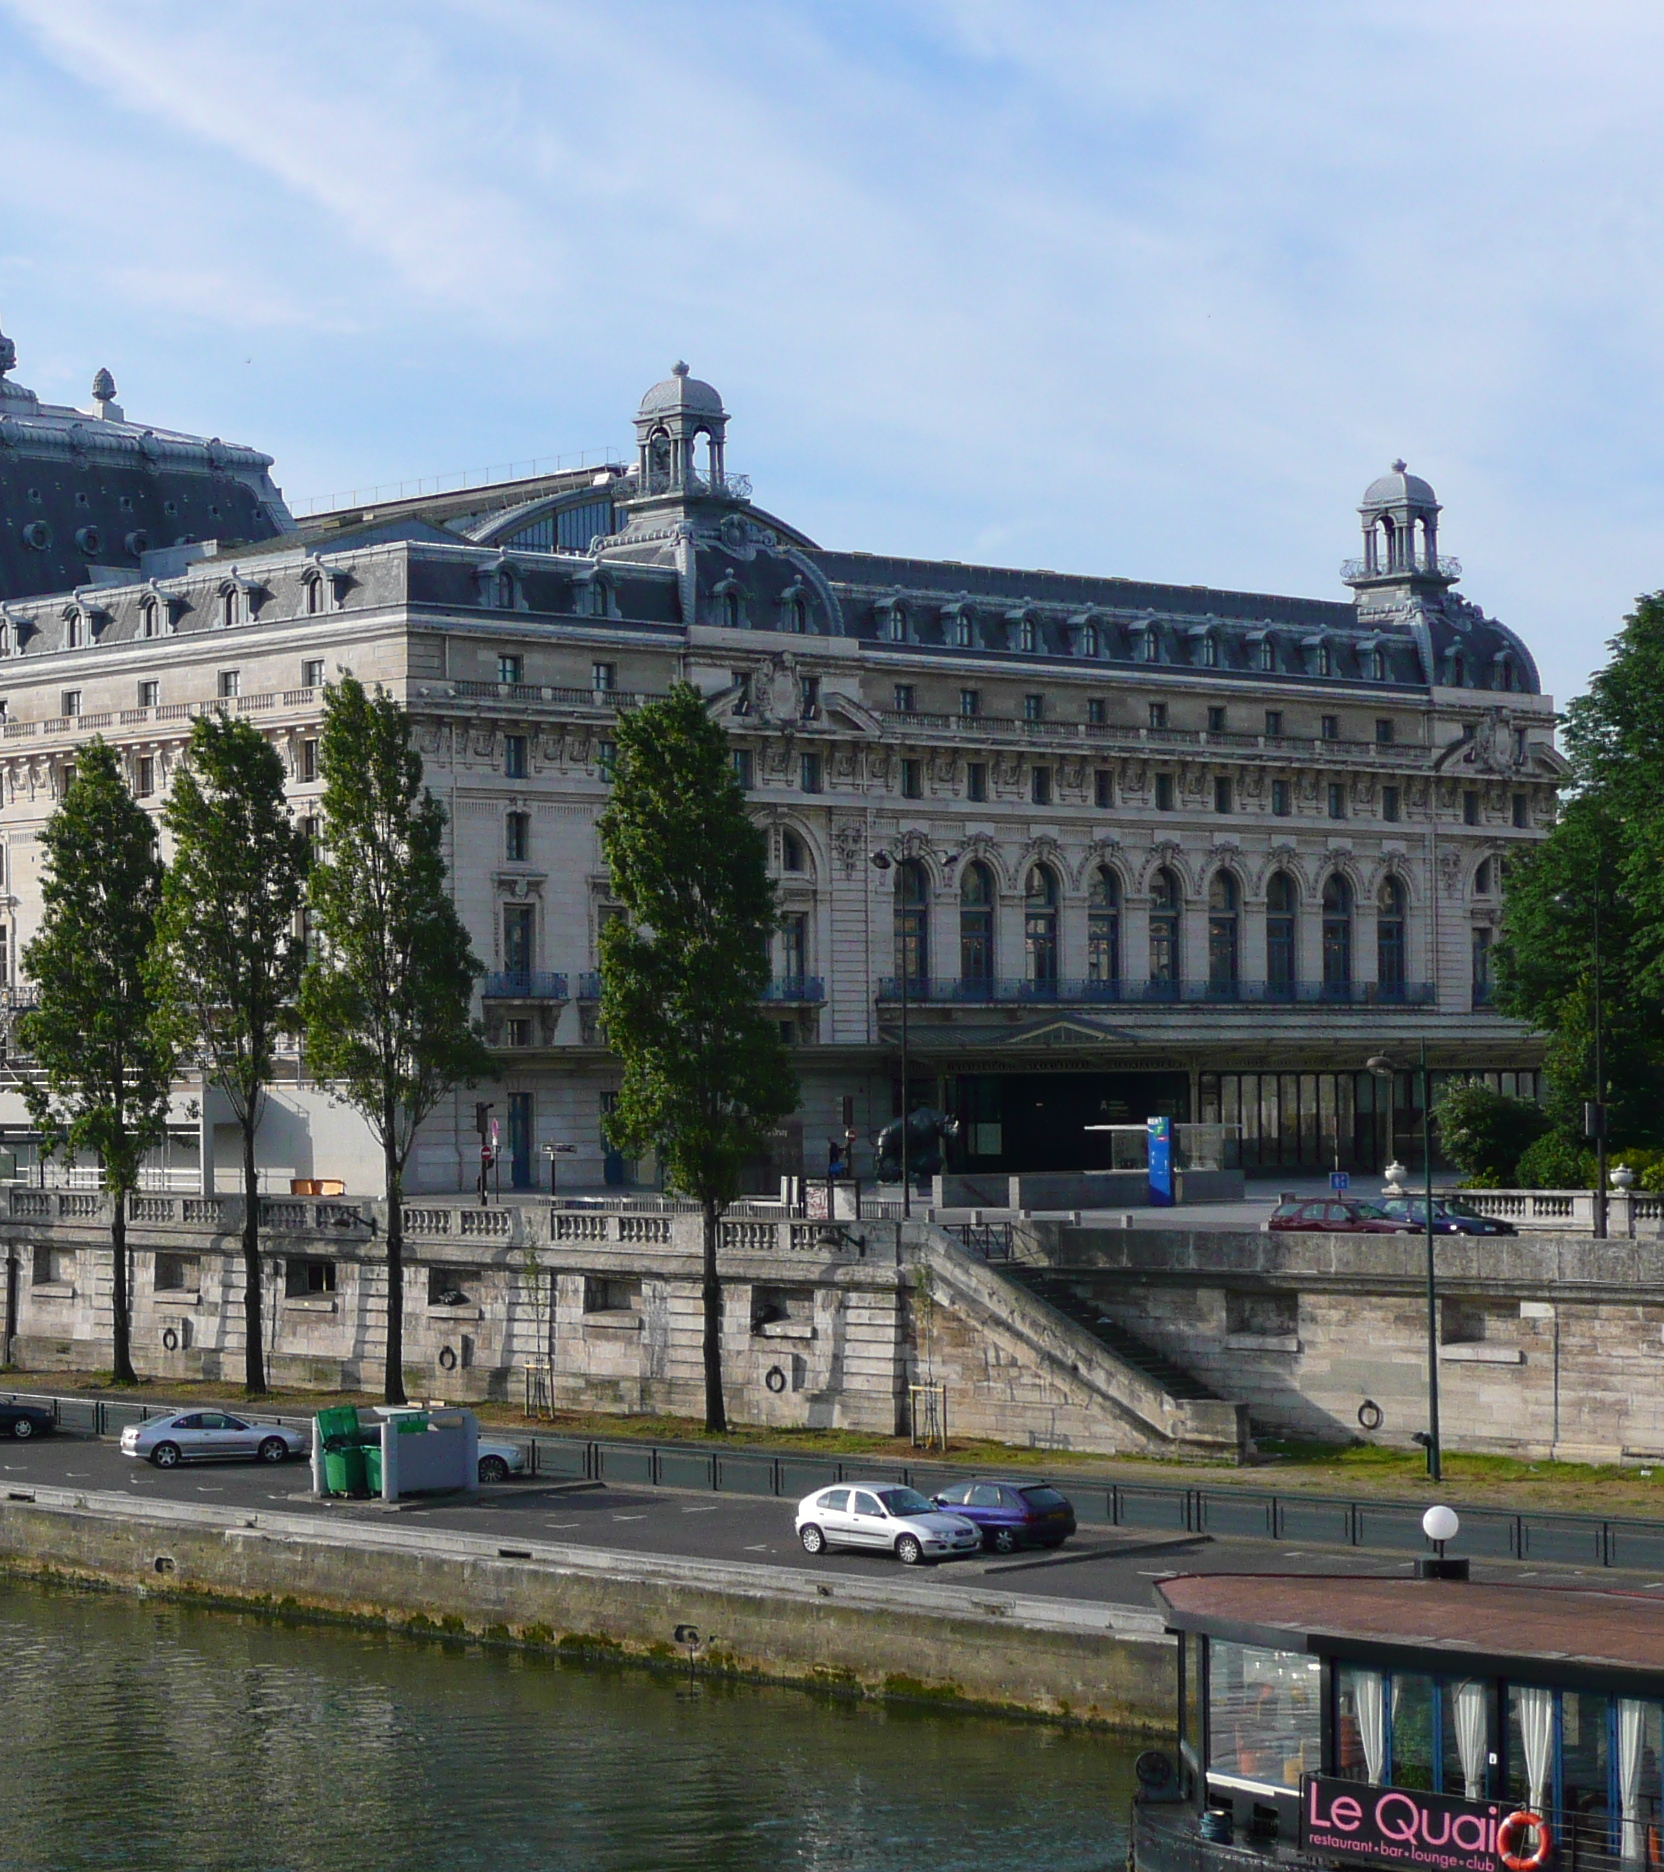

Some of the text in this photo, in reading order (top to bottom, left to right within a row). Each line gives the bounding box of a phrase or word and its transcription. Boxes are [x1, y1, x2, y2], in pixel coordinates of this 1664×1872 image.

[1310, 1781, 1497, 1853] Le Quai
[1309, 1834, 1495, 1872] restaurant bar lounge club
